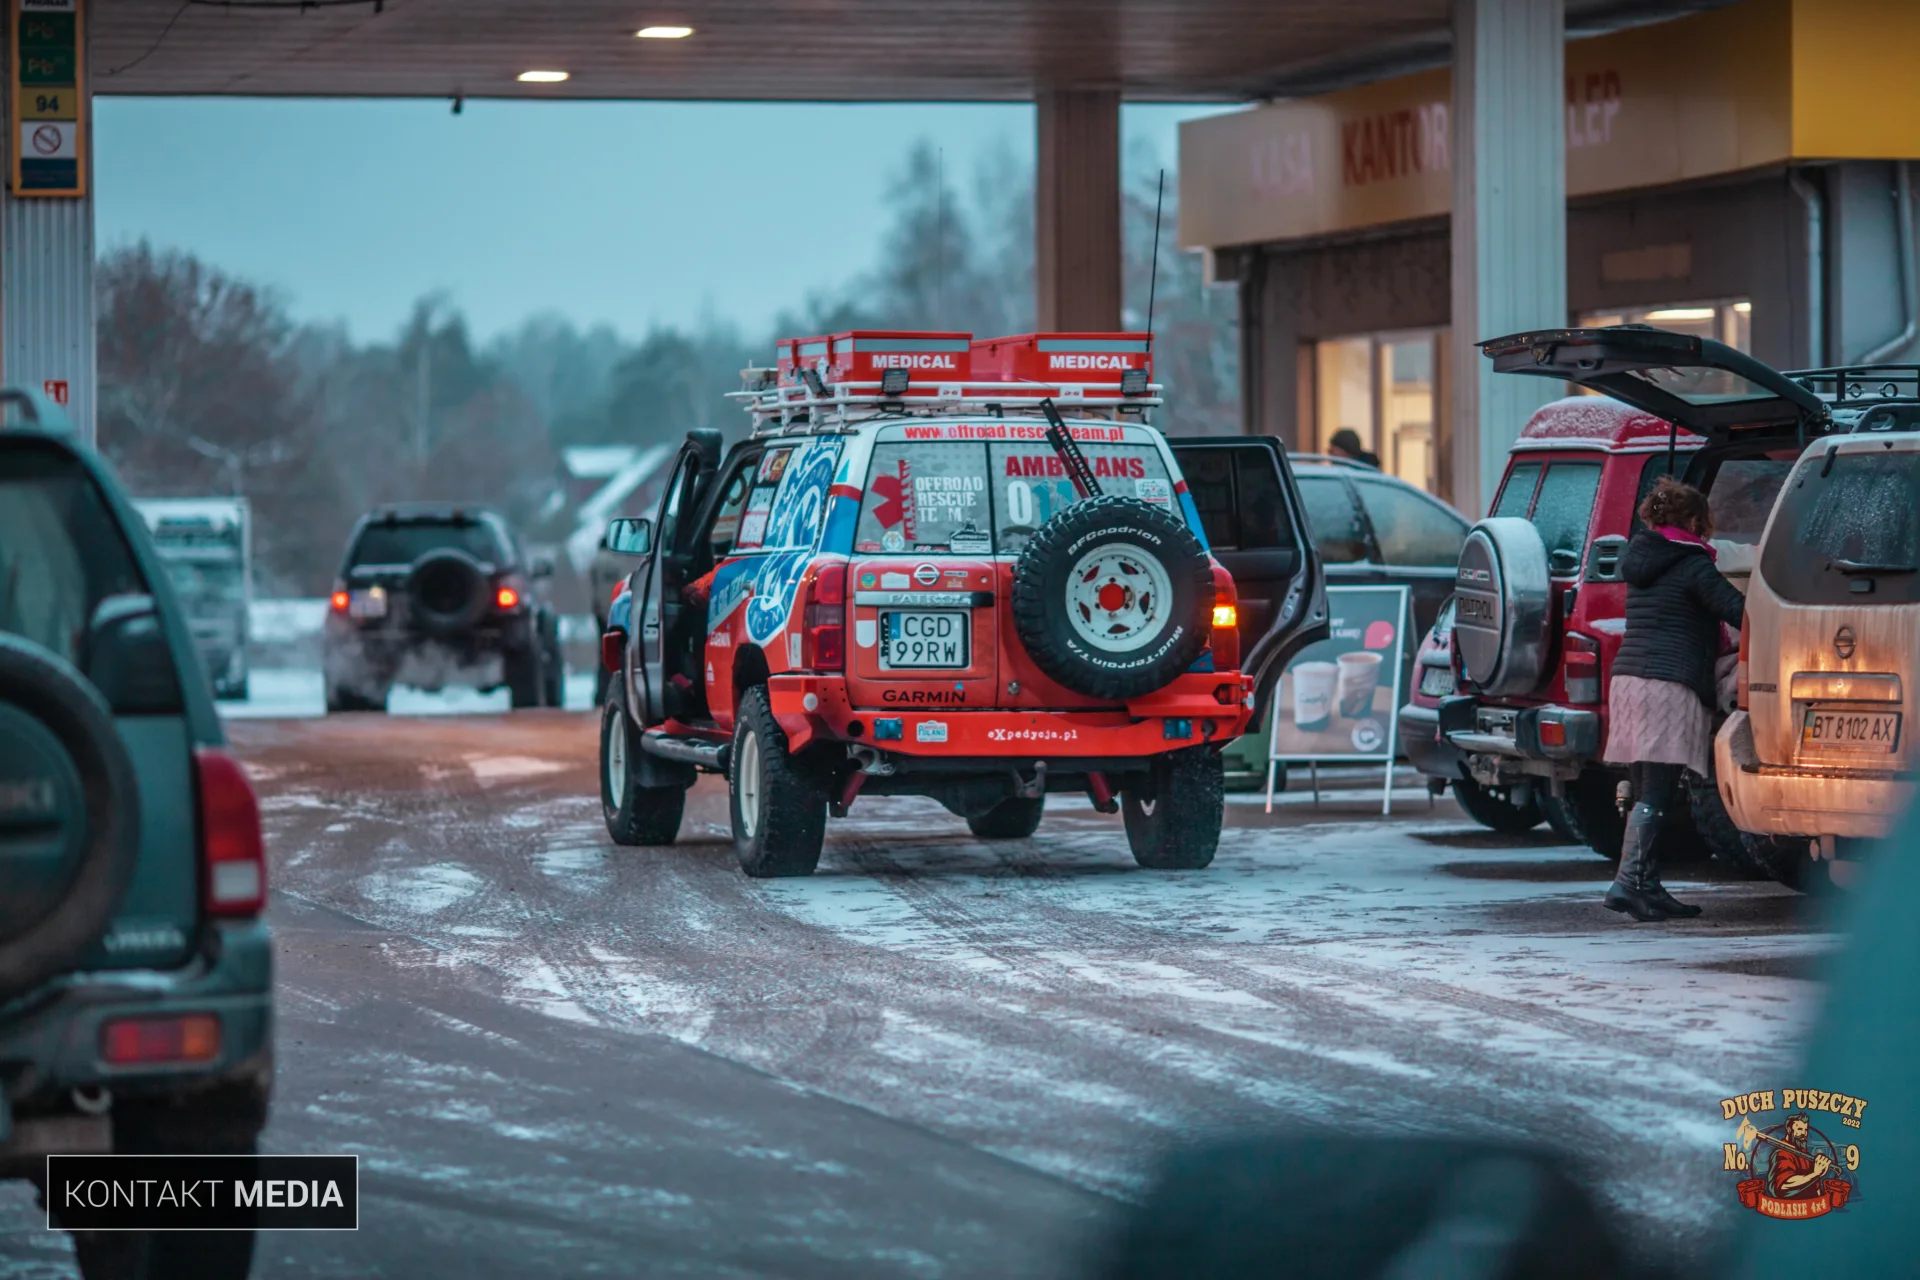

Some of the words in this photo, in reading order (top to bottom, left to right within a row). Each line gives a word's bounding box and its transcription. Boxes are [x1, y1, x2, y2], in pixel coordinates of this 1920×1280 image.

[36, 95, 59, 112] 94
[1567, 69, 1621, 146] LEP
[1250, 132, 1313, 198] KASA
[1342, 103, 1449, 187] KANTOR
[872, 354, 955, 369] MEDICAL
[1050, 355, 1132, 369] MEDICAL
[915, 476, 983, 491] OFFROAD
[917, 492, 977, 507] RESCUE
[1068, 526, 1162, 556] BFGoodrich
[889, 594, 972, 605] PATROL
[1459, 596, 1493, 620] PATROL
[904, 616, 951, 638] CGD
[896, 641, 956, 662] 99RW
[1065, 638, 1091, 662] T/A
[1092, 625, 1184, 669] Mud-Terrain
[882, 689, 966, 703] GARMIN
[988, 728, 1078, 741] eXpedycja.pl
[1812, 715, 1834, 738] BT
[1836, 717, 1870, 740] 8102
[1871, 718, 1894, 742] AX
